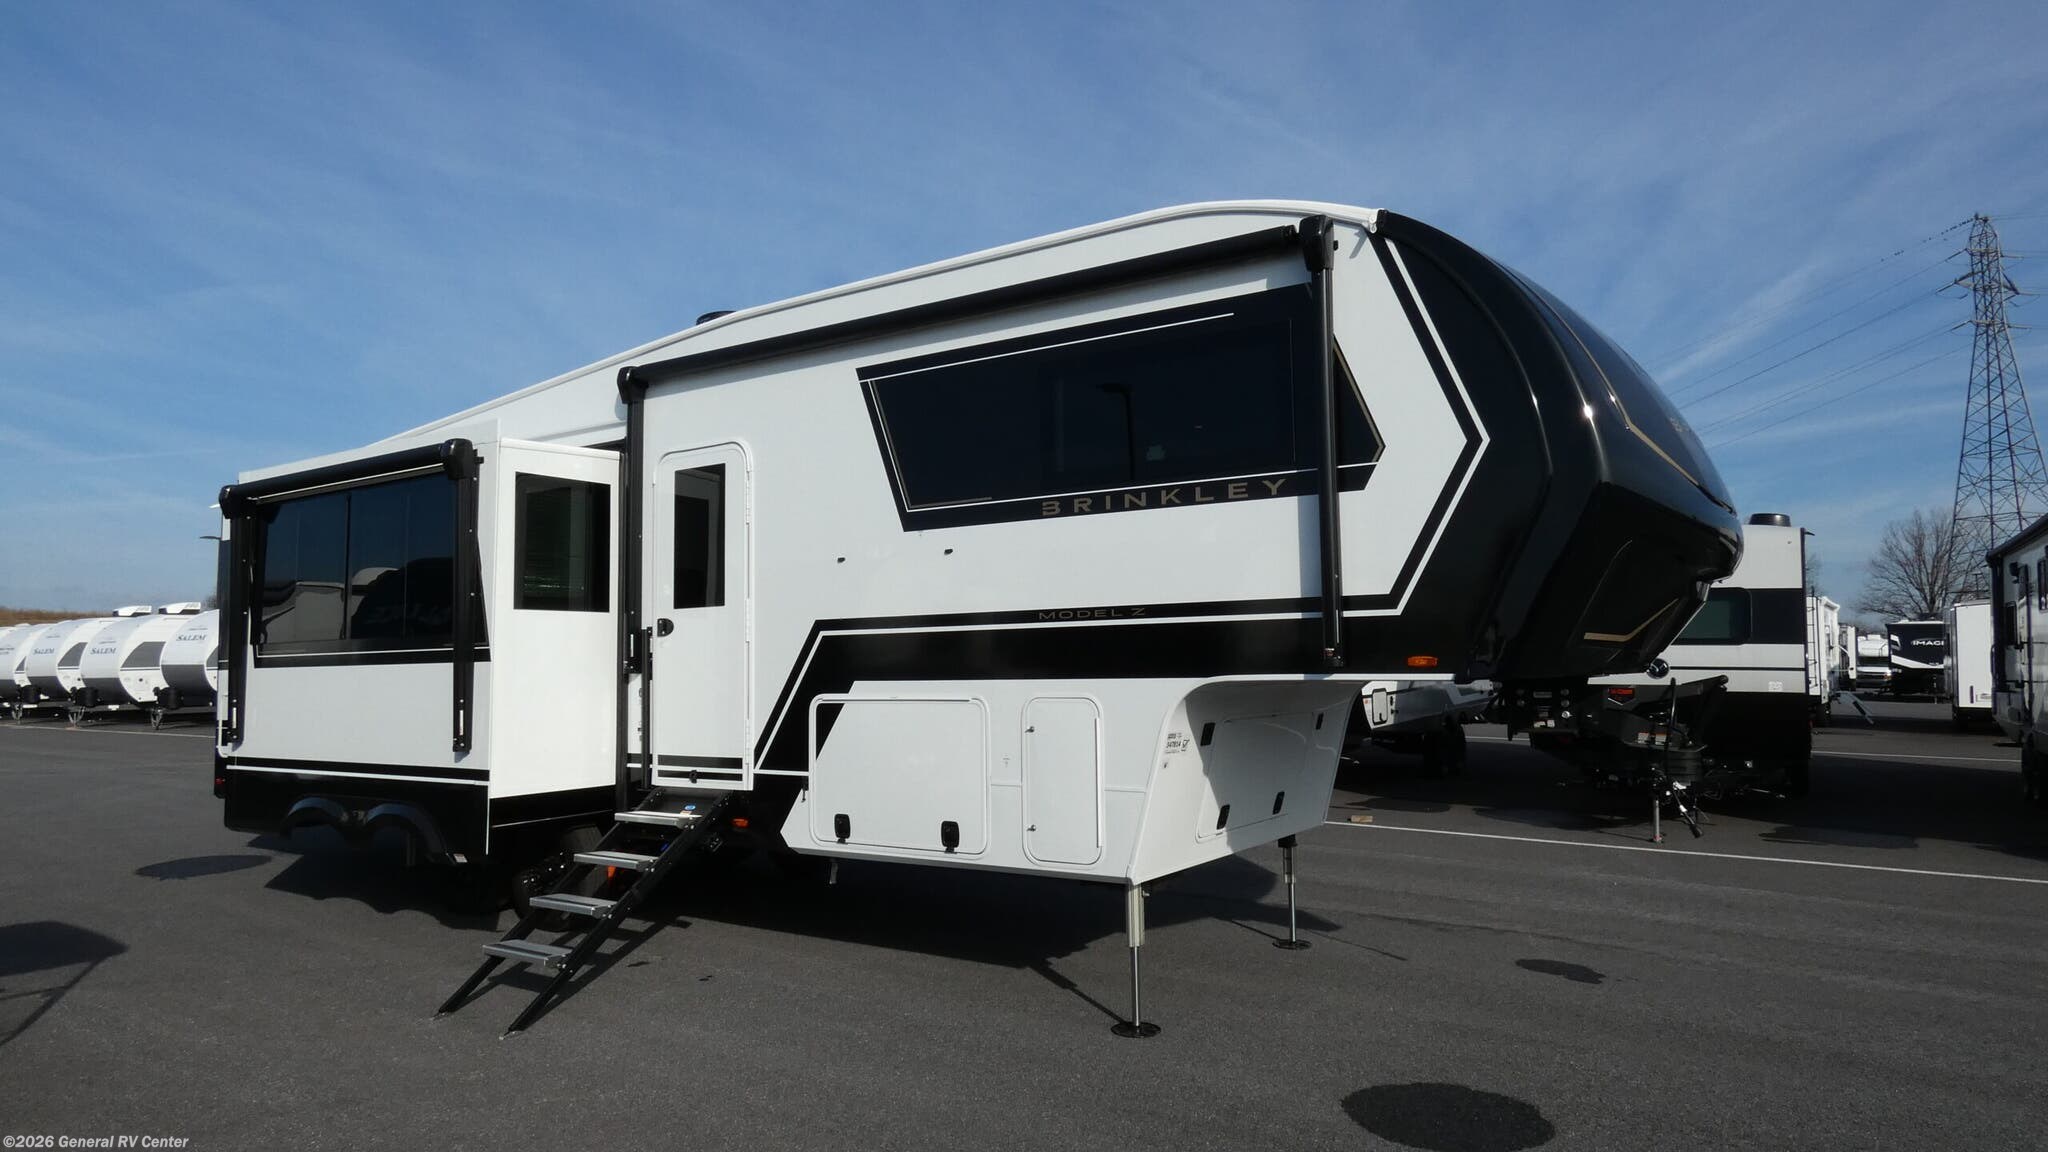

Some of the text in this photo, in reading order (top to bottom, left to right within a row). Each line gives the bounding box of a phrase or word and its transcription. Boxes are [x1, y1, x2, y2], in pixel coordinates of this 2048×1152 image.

[1041, 478, 1287, 517] BRINKLEY
[1038, 607, 1147, 621] MODEL Z
[33, 647, 55, 655] SALEM
[90, 647, 116, 655] SALEM
